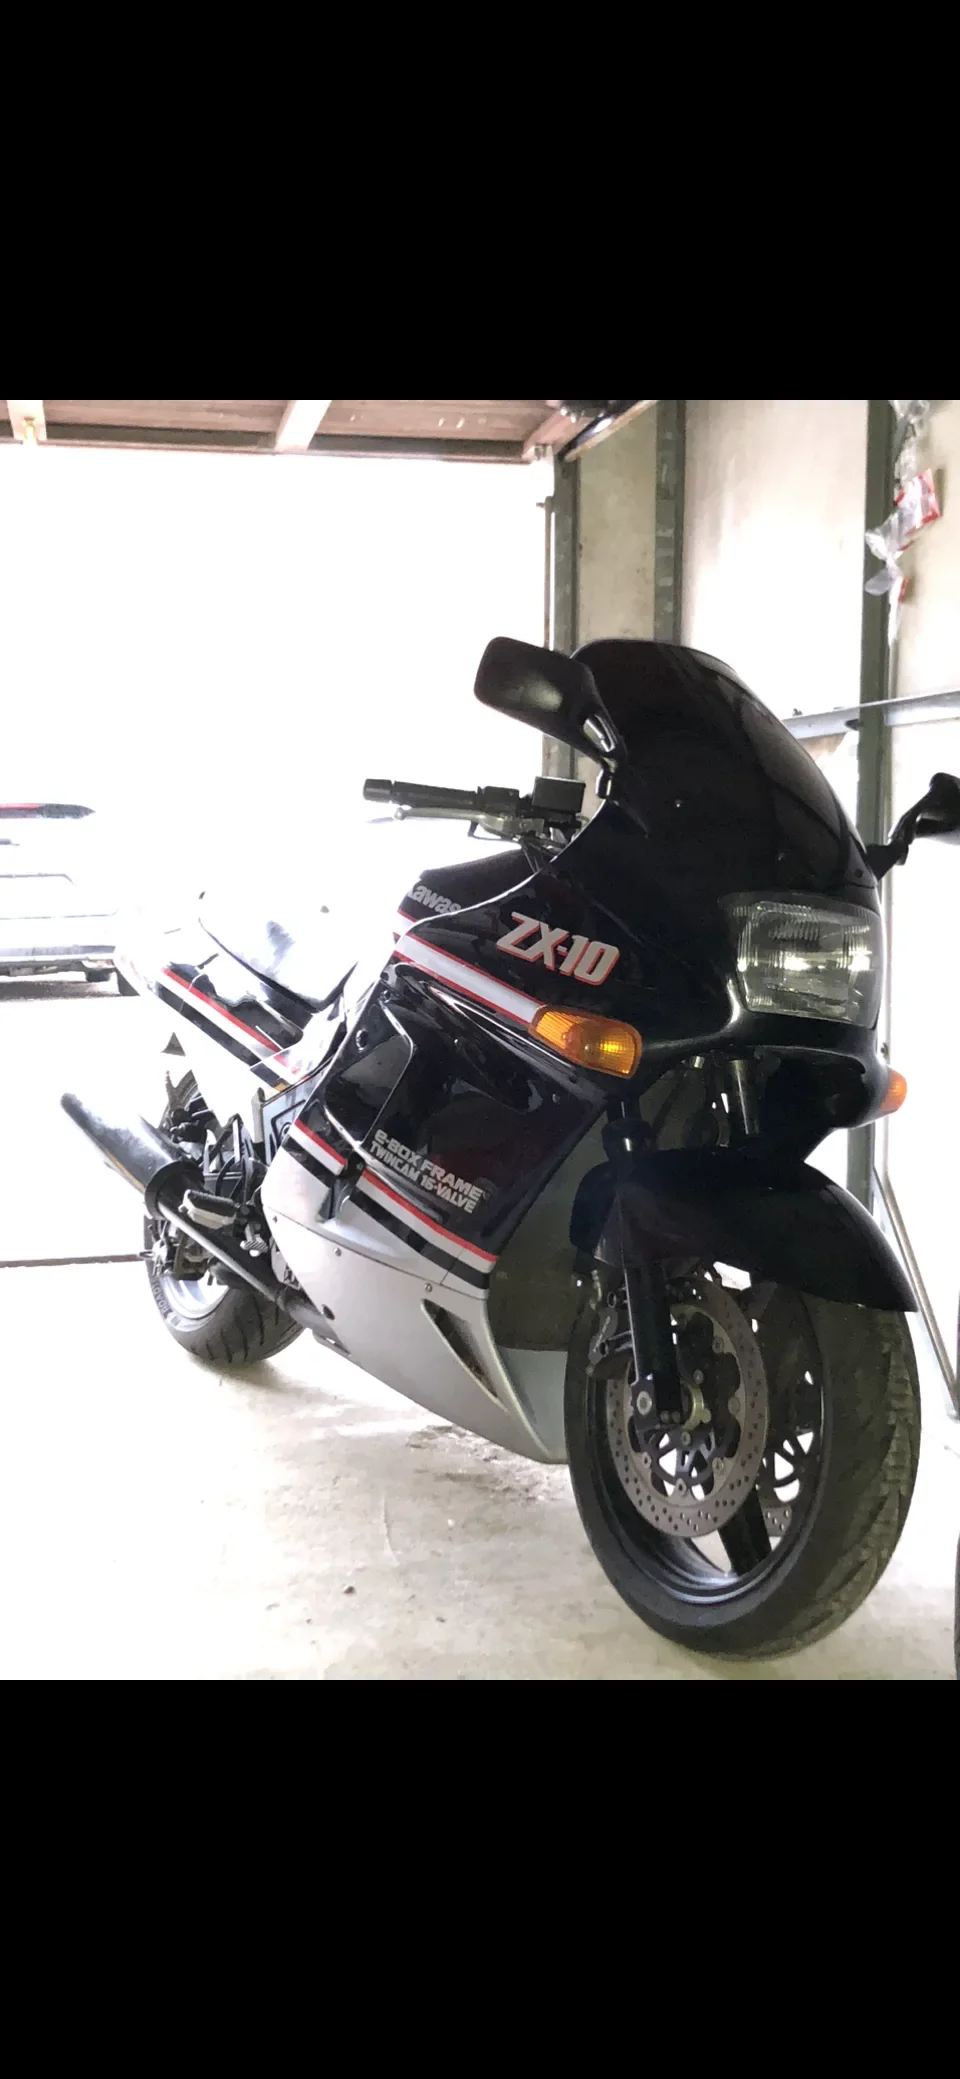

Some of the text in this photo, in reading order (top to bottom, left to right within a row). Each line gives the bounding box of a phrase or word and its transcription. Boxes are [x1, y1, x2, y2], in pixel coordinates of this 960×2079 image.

[496, 911, 620, 986] ZX-10
[370, 1141, 477, 1214] TWINCAM 16-VALVE
[421, 1159, 483, 1201] FRAME
